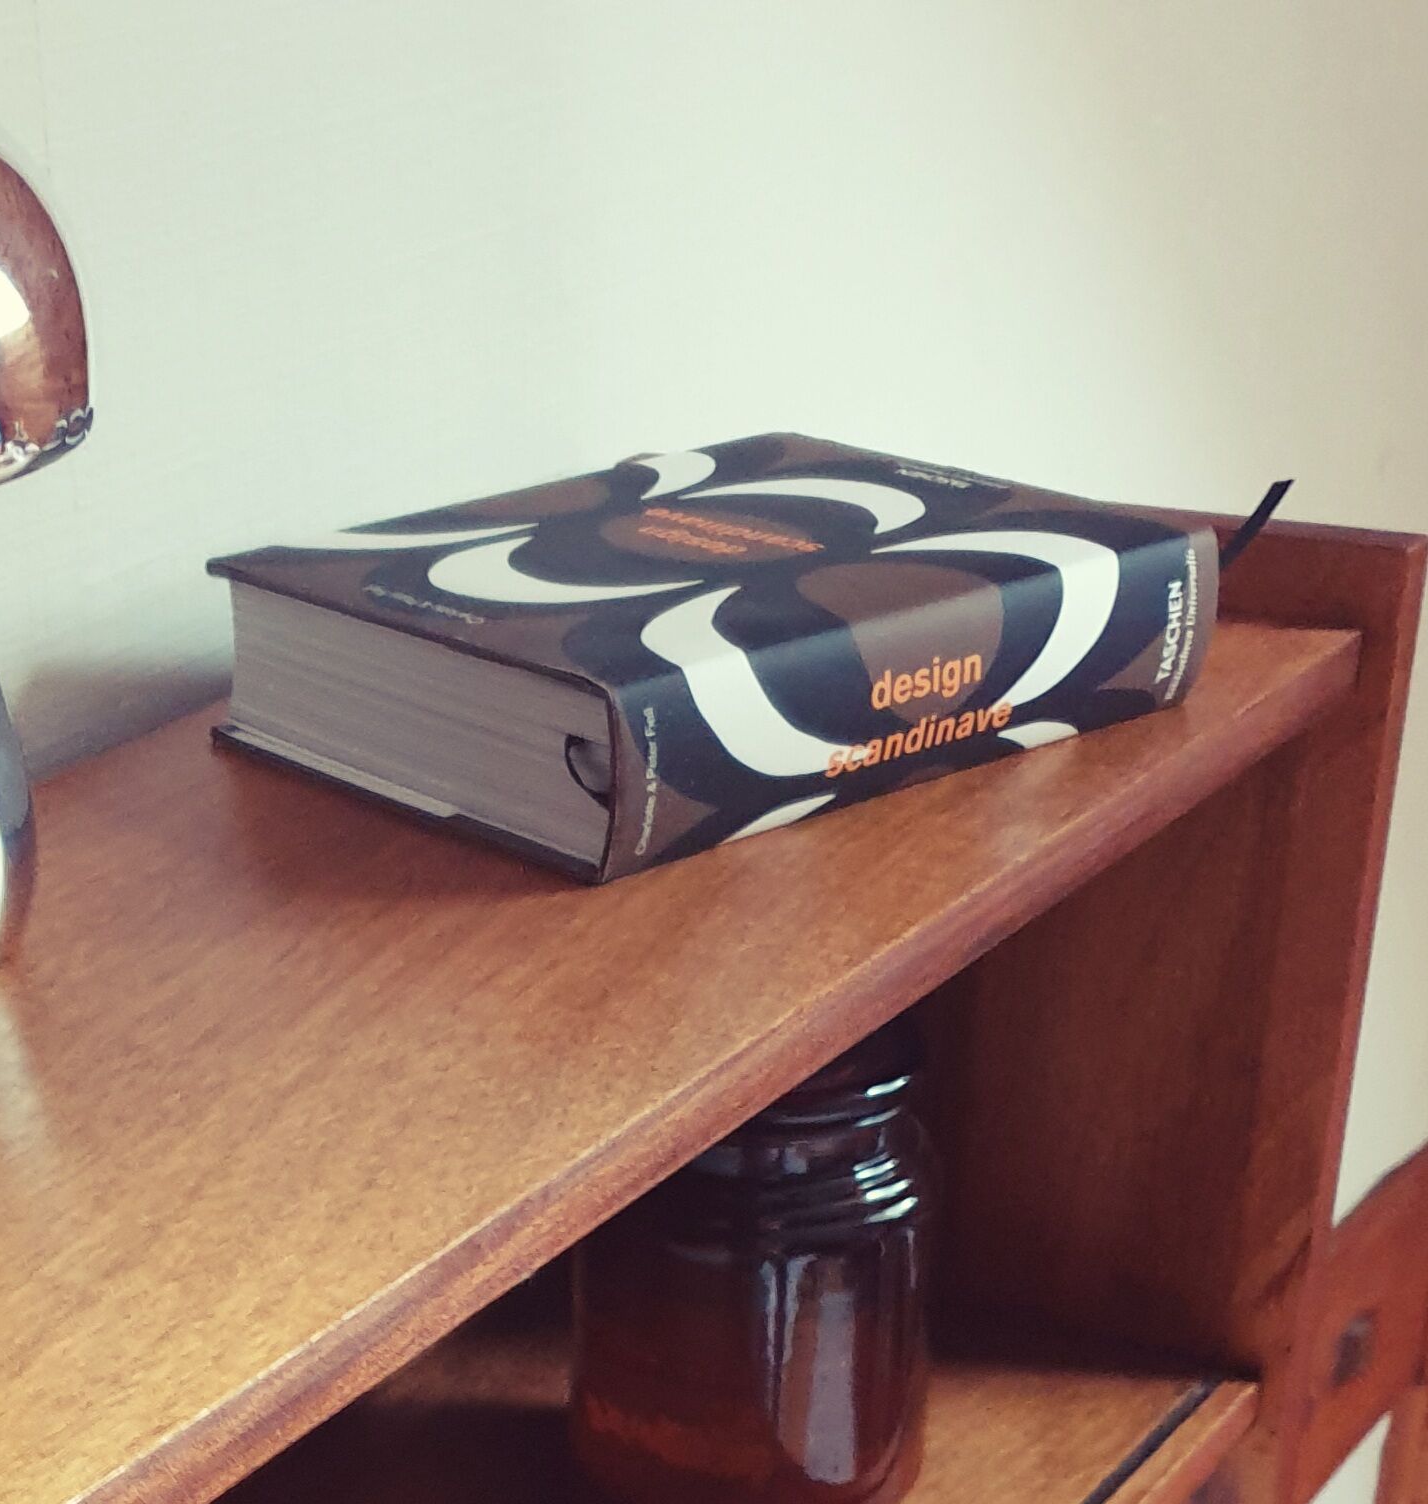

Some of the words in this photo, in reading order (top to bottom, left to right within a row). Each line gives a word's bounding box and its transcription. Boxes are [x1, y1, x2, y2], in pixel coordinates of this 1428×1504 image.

[1155, 578, 1183, 684] TASCHEN
[871, 654, 982, 710] design
[645, 741, 658, 780] Peter
[825, 701, 1012, 778] scandinave
